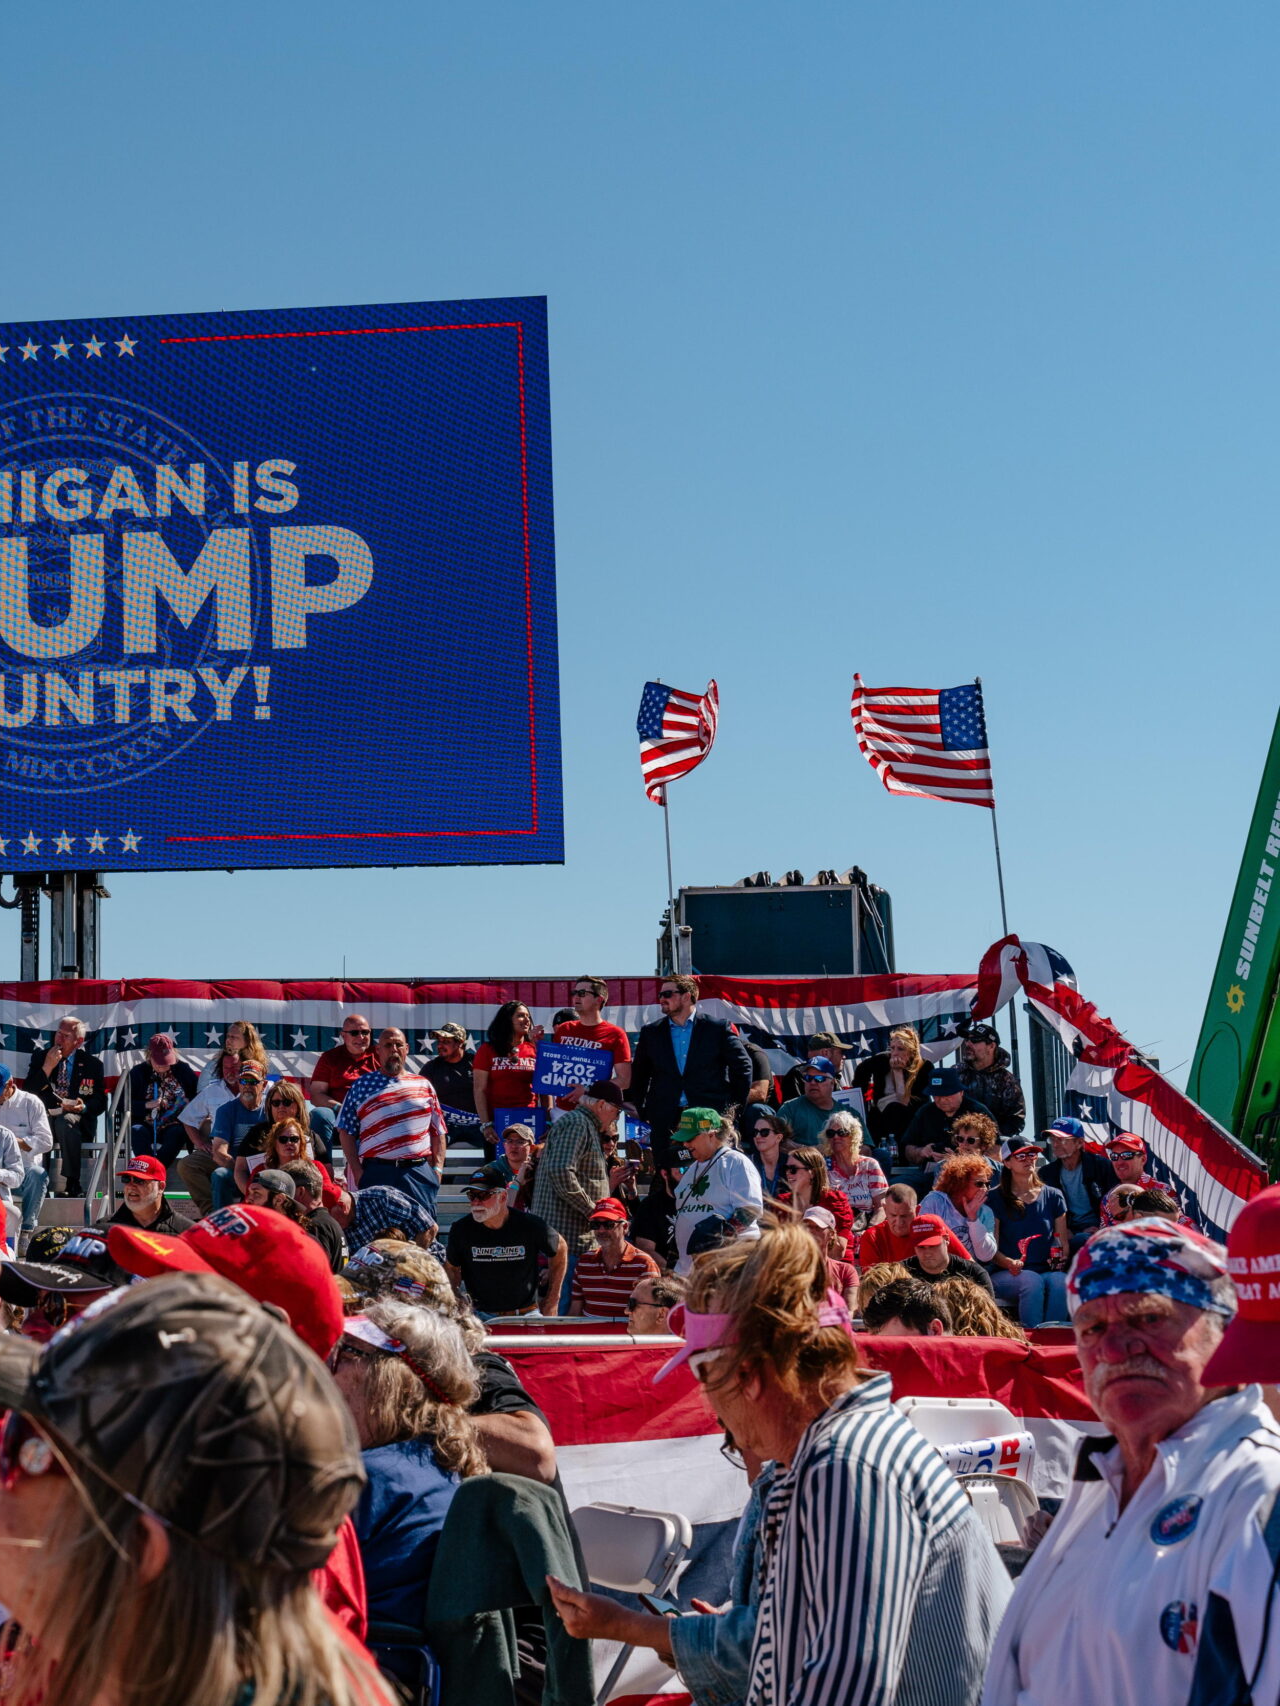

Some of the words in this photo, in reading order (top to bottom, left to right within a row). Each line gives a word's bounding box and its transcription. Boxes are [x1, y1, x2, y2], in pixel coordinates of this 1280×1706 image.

[24, 406, 88, 432] THE
[233, 459, 300, 514] IS
[1235, 858, 1275, 980] SUNBELT
[560, 1036, 603, 1049] TRUMP
[541, 1072, 598, 1088] RUMP
[551, 1060, 596, 1078] 2024
